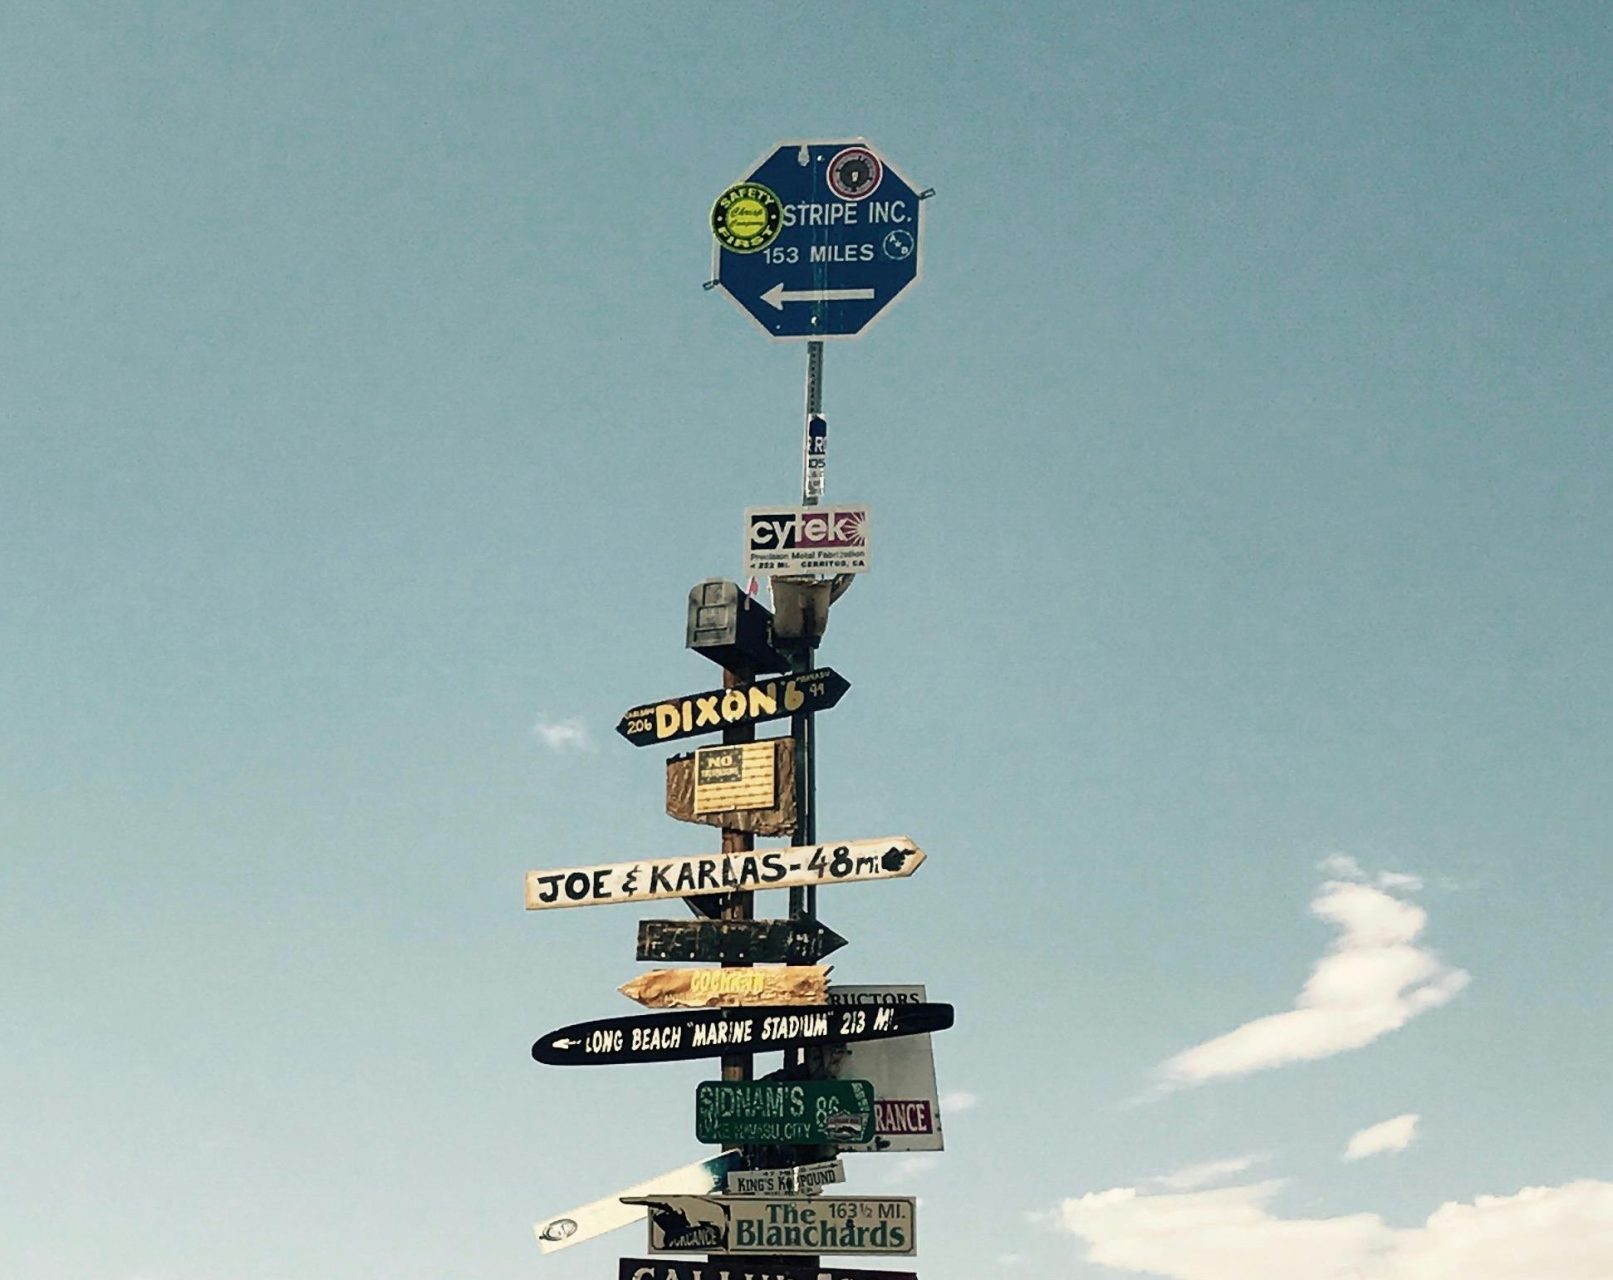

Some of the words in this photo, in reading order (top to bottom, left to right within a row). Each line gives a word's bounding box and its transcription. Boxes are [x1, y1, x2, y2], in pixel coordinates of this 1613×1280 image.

[720, 187, 775, 208] SAFETY
[782, 202, 857, 227] STRIPE
[868, 200, 912, 224] INC.
[717, 225, 773, 248] FIRST
[763, 247, 800, 264] 153
[809, 244, 874, 263] MILES
[751, 513, 850, 550] cytek
[852, 559, 865, 567] CA
[656, 681, 777, 739] DIXON
[626, 718, 653, 735] 206
[707, 755, 733, 768] NO
[537, 869, 613, 904] JOE
[622, 866, 640, 897] &
[585, 1032, 624, 1054] LONG
[632, 1025, 681, 1050] BEACH
[840, 1010, 866, 1036] 213
[737, 1177, 774, 1192] KING'S
[766, 1203, 817, 1225] The
[878, 1206, 906, 1219] MI.
[736, 1219, 906, 1248] Blanchards
